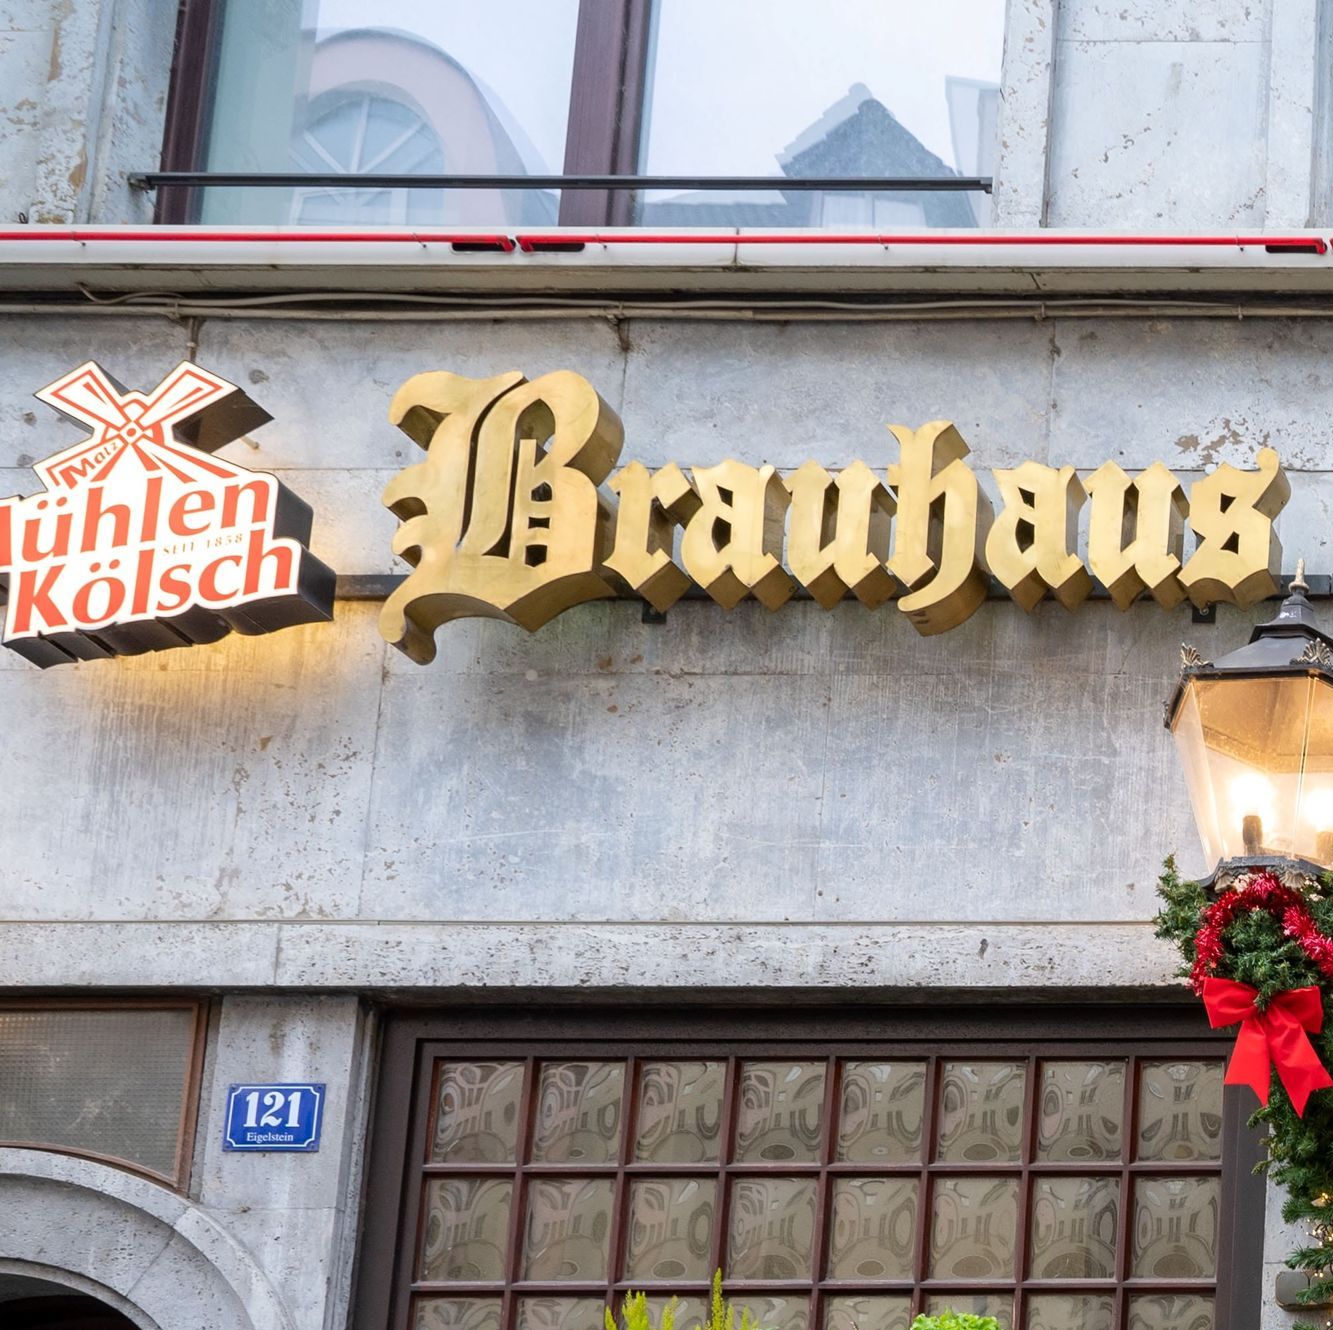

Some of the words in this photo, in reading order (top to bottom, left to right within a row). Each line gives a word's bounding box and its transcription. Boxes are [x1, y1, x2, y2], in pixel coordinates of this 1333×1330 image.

[58, 441, 119, 489] Malz
[0, 476, 271, 566] ühlen
[378, 369, 1290, 664] Brauhaus
[12, 528, 294, 634] Kölsch
[243, 1091, 302, 1128] 121
[246, 1132, 294, 1144] Eigelstein
